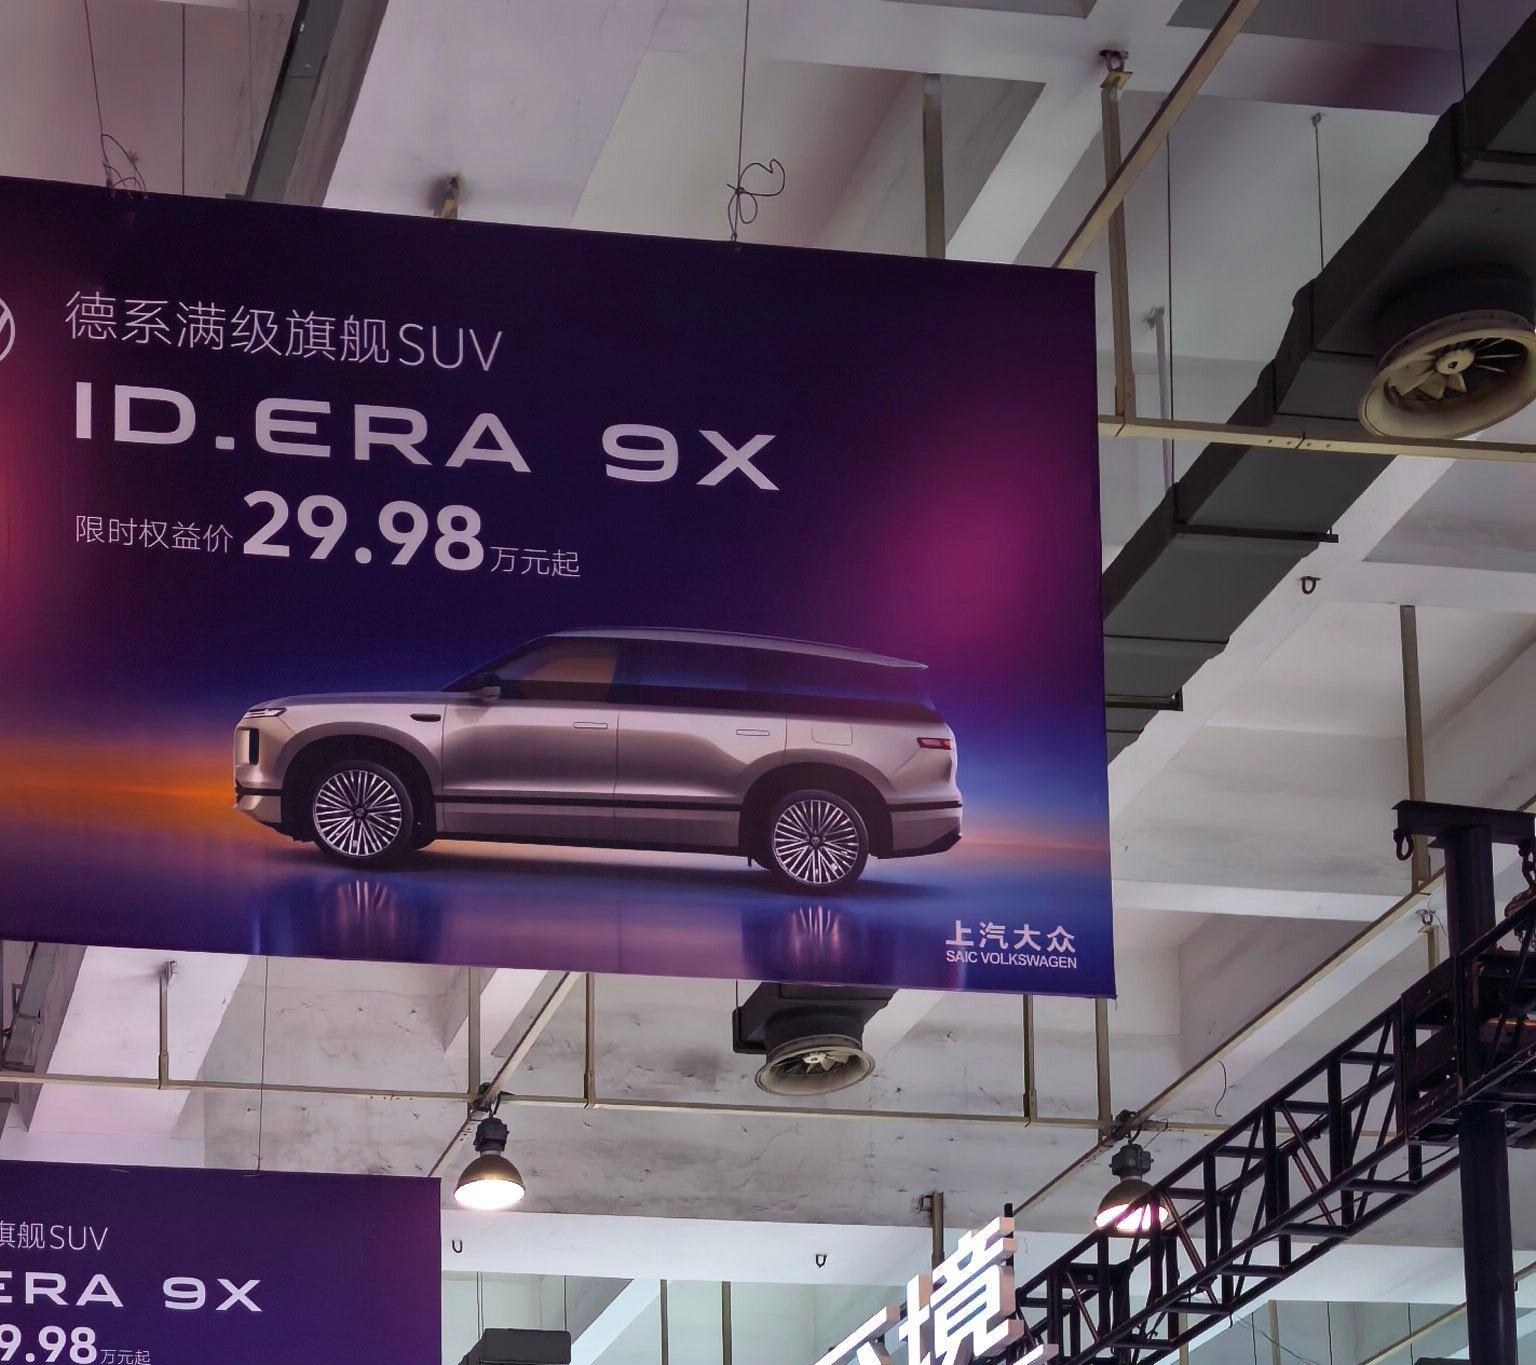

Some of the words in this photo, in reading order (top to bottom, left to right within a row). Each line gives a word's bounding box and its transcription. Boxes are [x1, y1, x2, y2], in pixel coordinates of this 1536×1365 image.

[65, 290, 503, 373] 德系满级旗舰SUV
[76, 382, 531, 475] ID.ERA
[604, 422, 780, 491] 9X
[945, 919, 1076, 954] 上汽大众
[946, 949, 980, 967] SAIC
[982, 951, 1078, 971] VOLKSWAGEN
[164, 1276, 262, 1312] 9X
